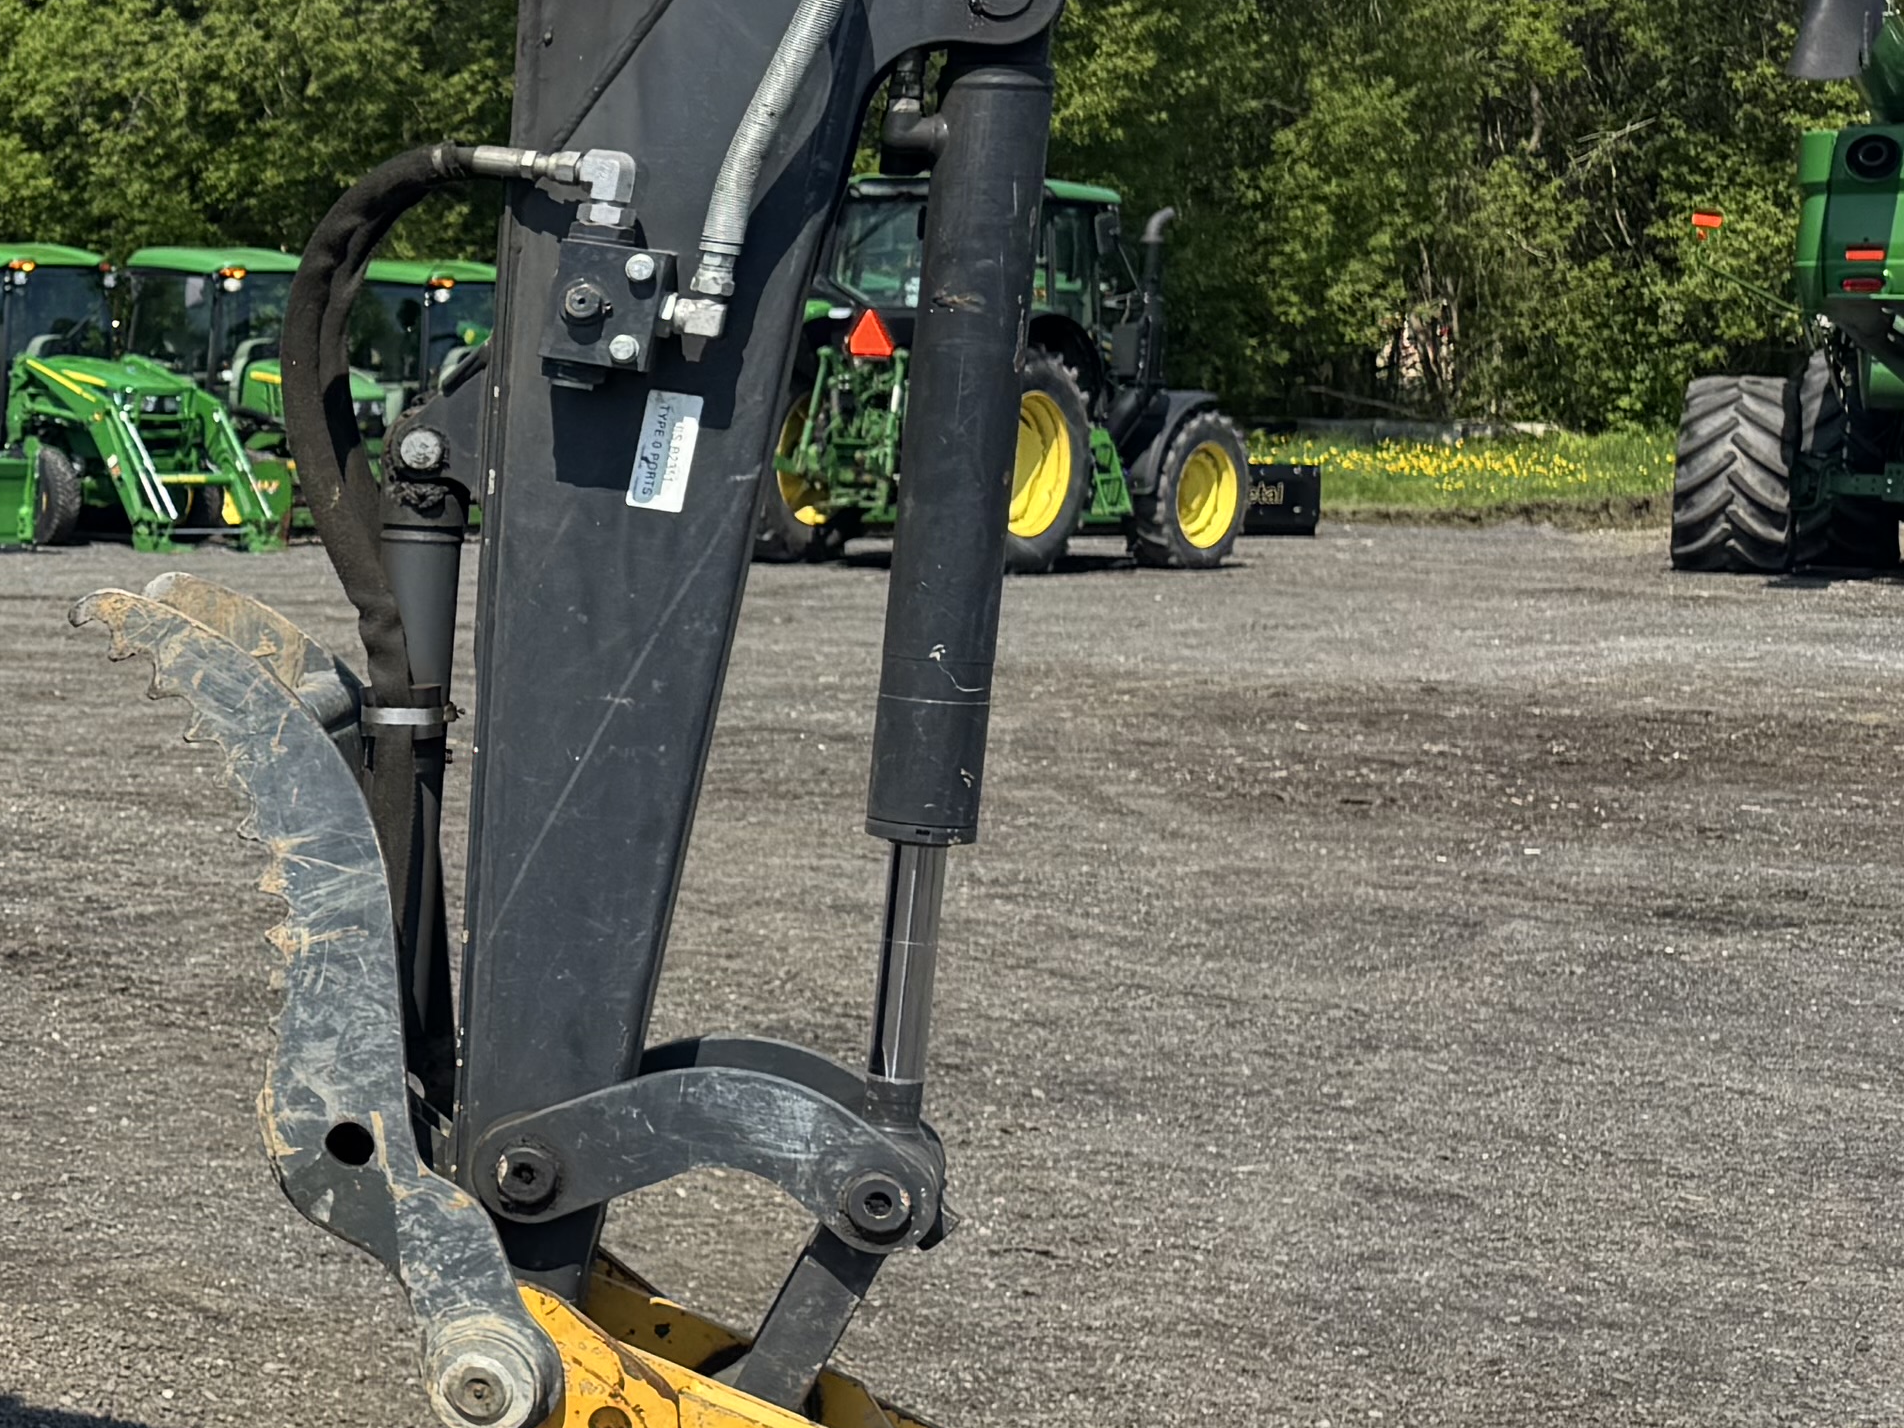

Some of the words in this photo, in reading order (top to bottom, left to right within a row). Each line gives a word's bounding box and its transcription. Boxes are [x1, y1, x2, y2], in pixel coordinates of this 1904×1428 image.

[653, 403, 671, 437] TYPE
[642, 452, 660, 496] PORTS
[1248, 481, 1284, 505] etal
